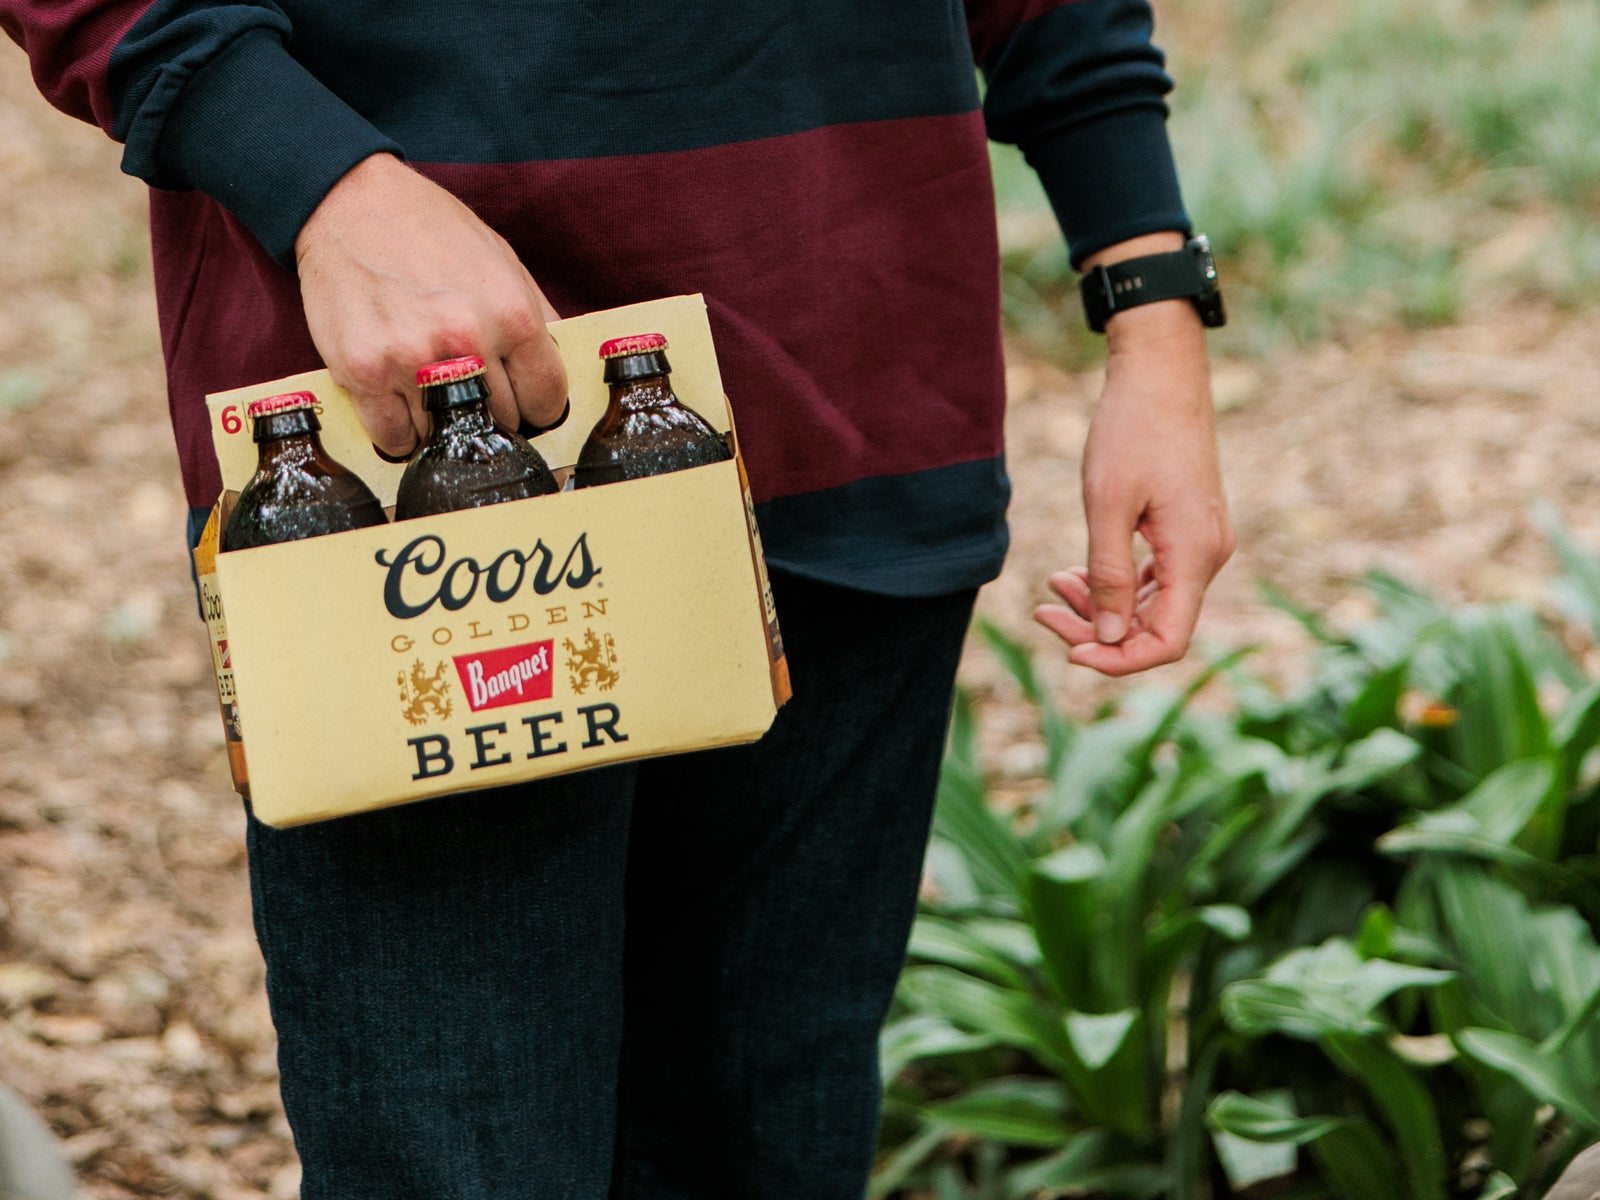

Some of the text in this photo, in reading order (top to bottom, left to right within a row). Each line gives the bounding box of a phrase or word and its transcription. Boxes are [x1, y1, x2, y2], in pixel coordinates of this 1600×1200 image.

[221, 405, 242, 435] 6
[375, 532, 602, 619] Coors
[391, 598, 609, 653] GOLDEN
[467, 646, 550, 707] Banquet
[407, 702, 630, 781] BEER
